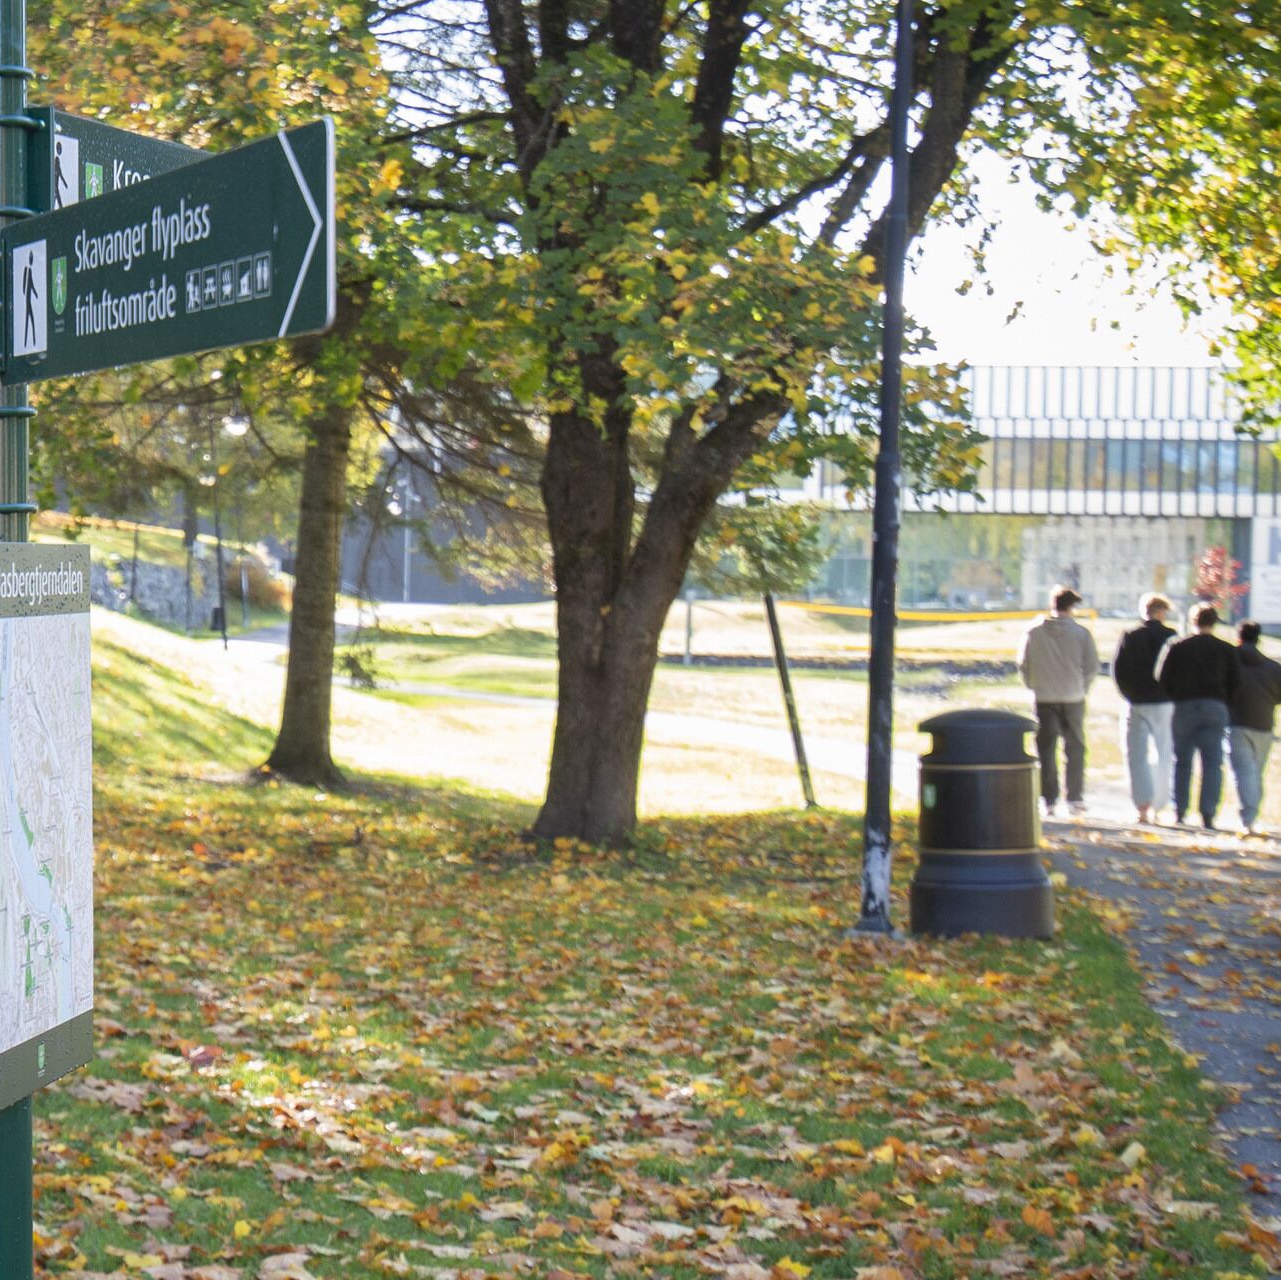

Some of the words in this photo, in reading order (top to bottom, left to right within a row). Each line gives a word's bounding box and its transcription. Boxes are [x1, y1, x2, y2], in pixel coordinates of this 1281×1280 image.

[74, 222, 147, 274] Skavanger
[151, 198, 211, 257] flyplass
[75, 277, 177, 337] friluftsområde
